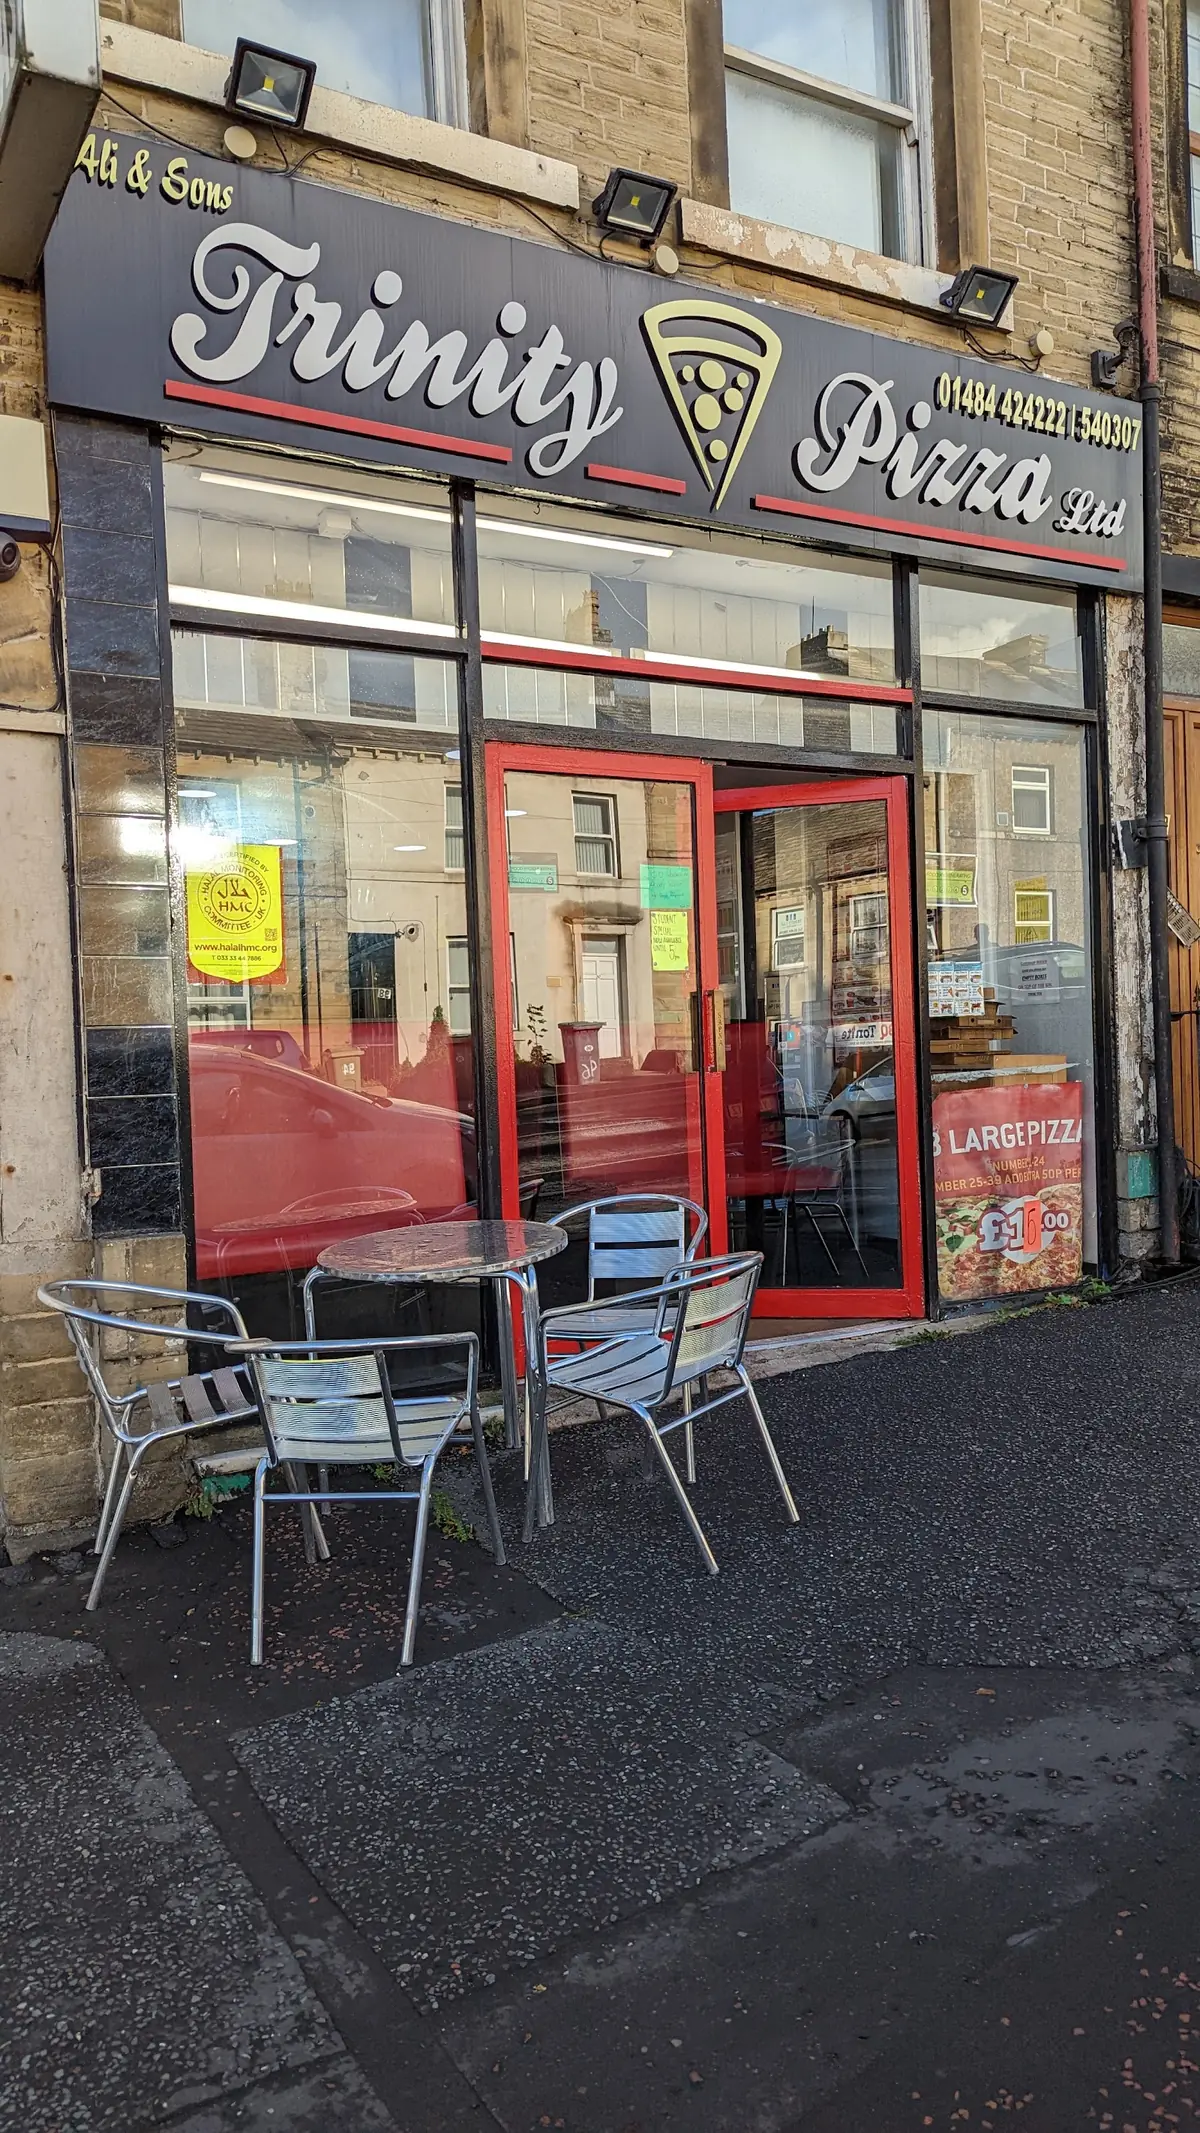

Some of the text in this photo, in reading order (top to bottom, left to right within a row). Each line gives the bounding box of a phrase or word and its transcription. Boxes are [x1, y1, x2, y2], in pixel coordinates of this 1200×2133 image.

[75, 134, 233, 211] Ali & Sons
[171, 222, 1126, 536] Trinity Pizza Ltd
[938, 371, 996, 418] 01484
[1001, 387, 1066, 435] 424222
[1082, 406, 1142, 451] 540307
[202, 864, 267, 896] HALAL MONITORING
[260, 864, 269, 873] BY
[203, 905, 252, 931] COMMITTEE
[255, 906, 267, 920] UK
[218, 901, 252, 913] HMC
[194, 942, 278, 954] www.halalhmc.org
[949, 1121, 1026, 1155] LARGE
[969, 1175, 1002, 1189] 25-39
[1042, 1168, 1062, 1180] 50P
